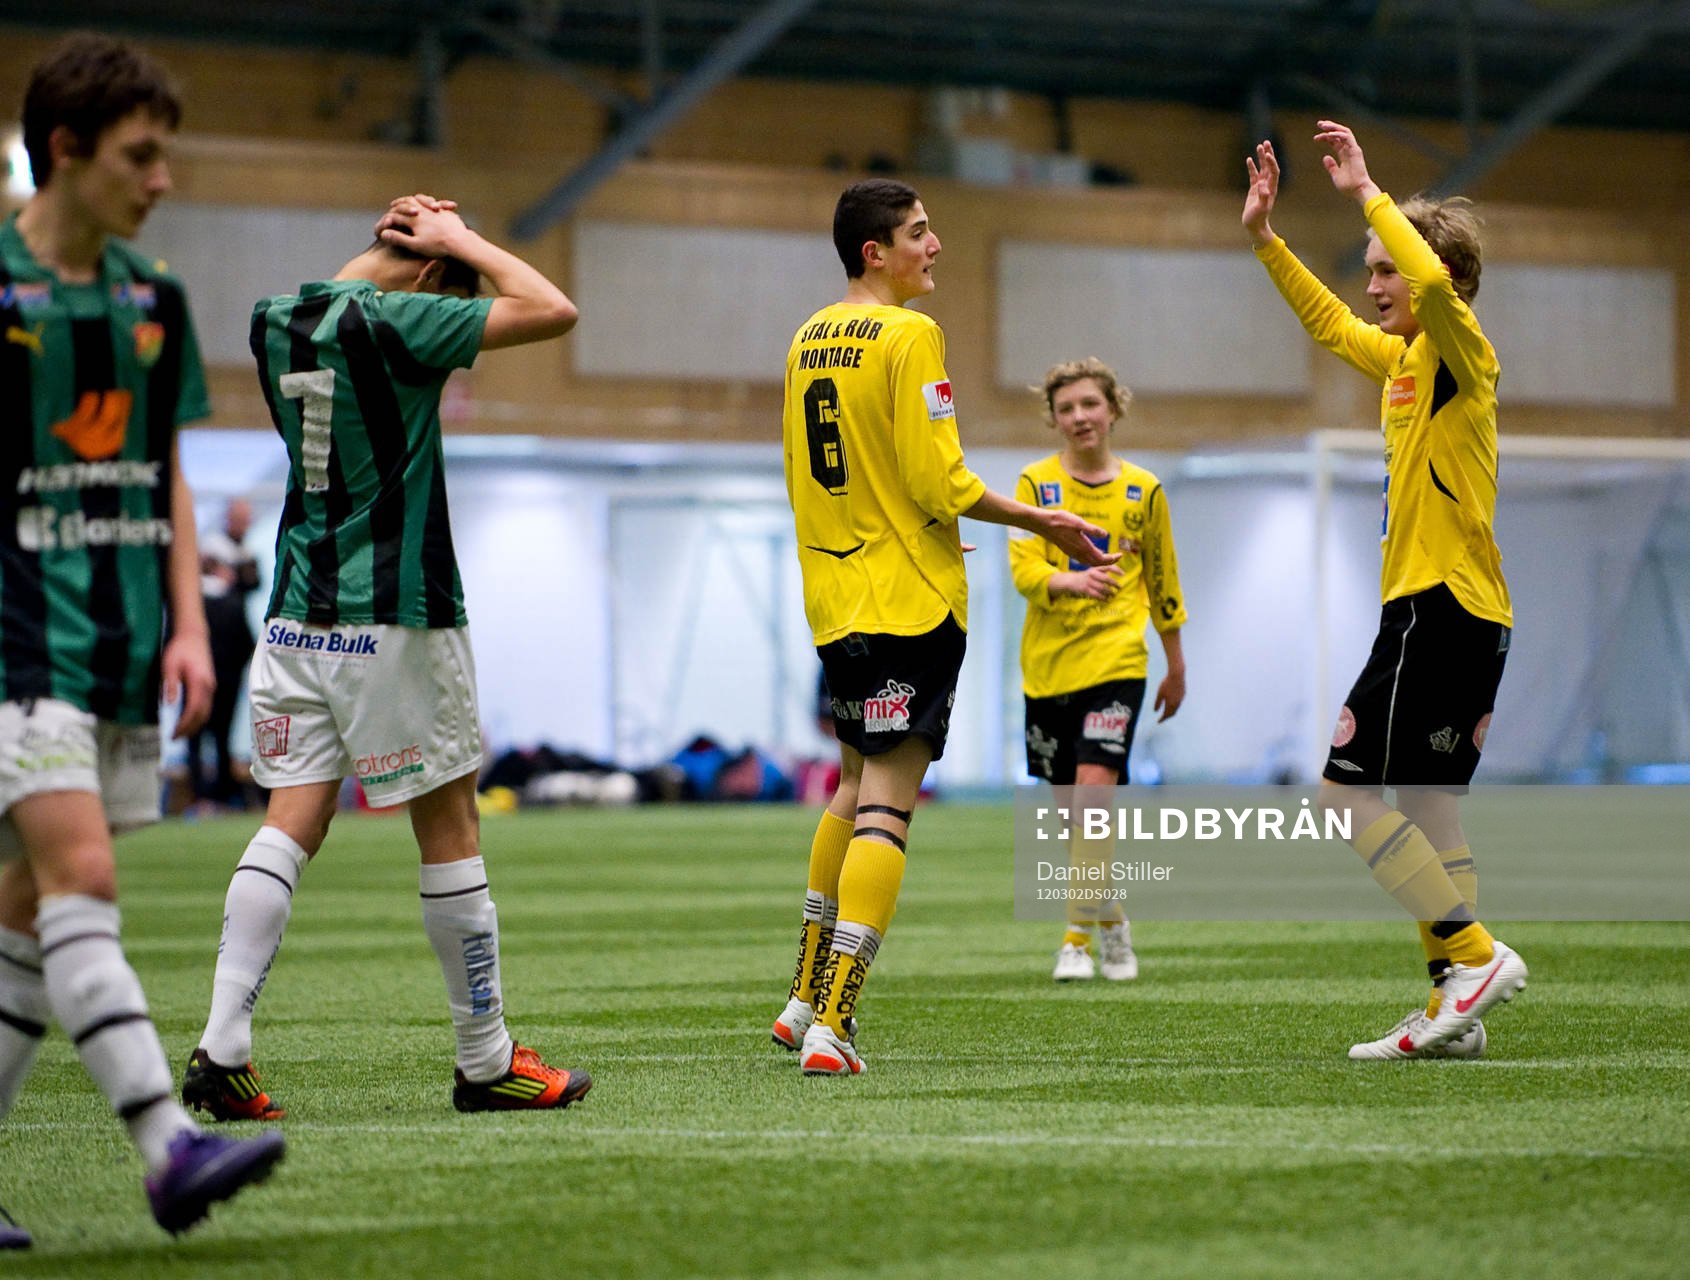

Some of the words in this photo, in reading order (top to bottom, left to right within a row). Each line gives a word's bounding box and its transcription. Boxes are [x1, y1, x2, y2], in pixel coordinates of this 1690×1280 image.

[831, 322, 842, 339] &
[843, 316, 883, 341] RÖR
[798, 346, 864, 371] MONTAGE
[279, 368, 336, 492] 7
[804, 377, 849, 496] 6
[266, 624, 326, 651] Stena
[326, 631, 379, 655] Bulk
